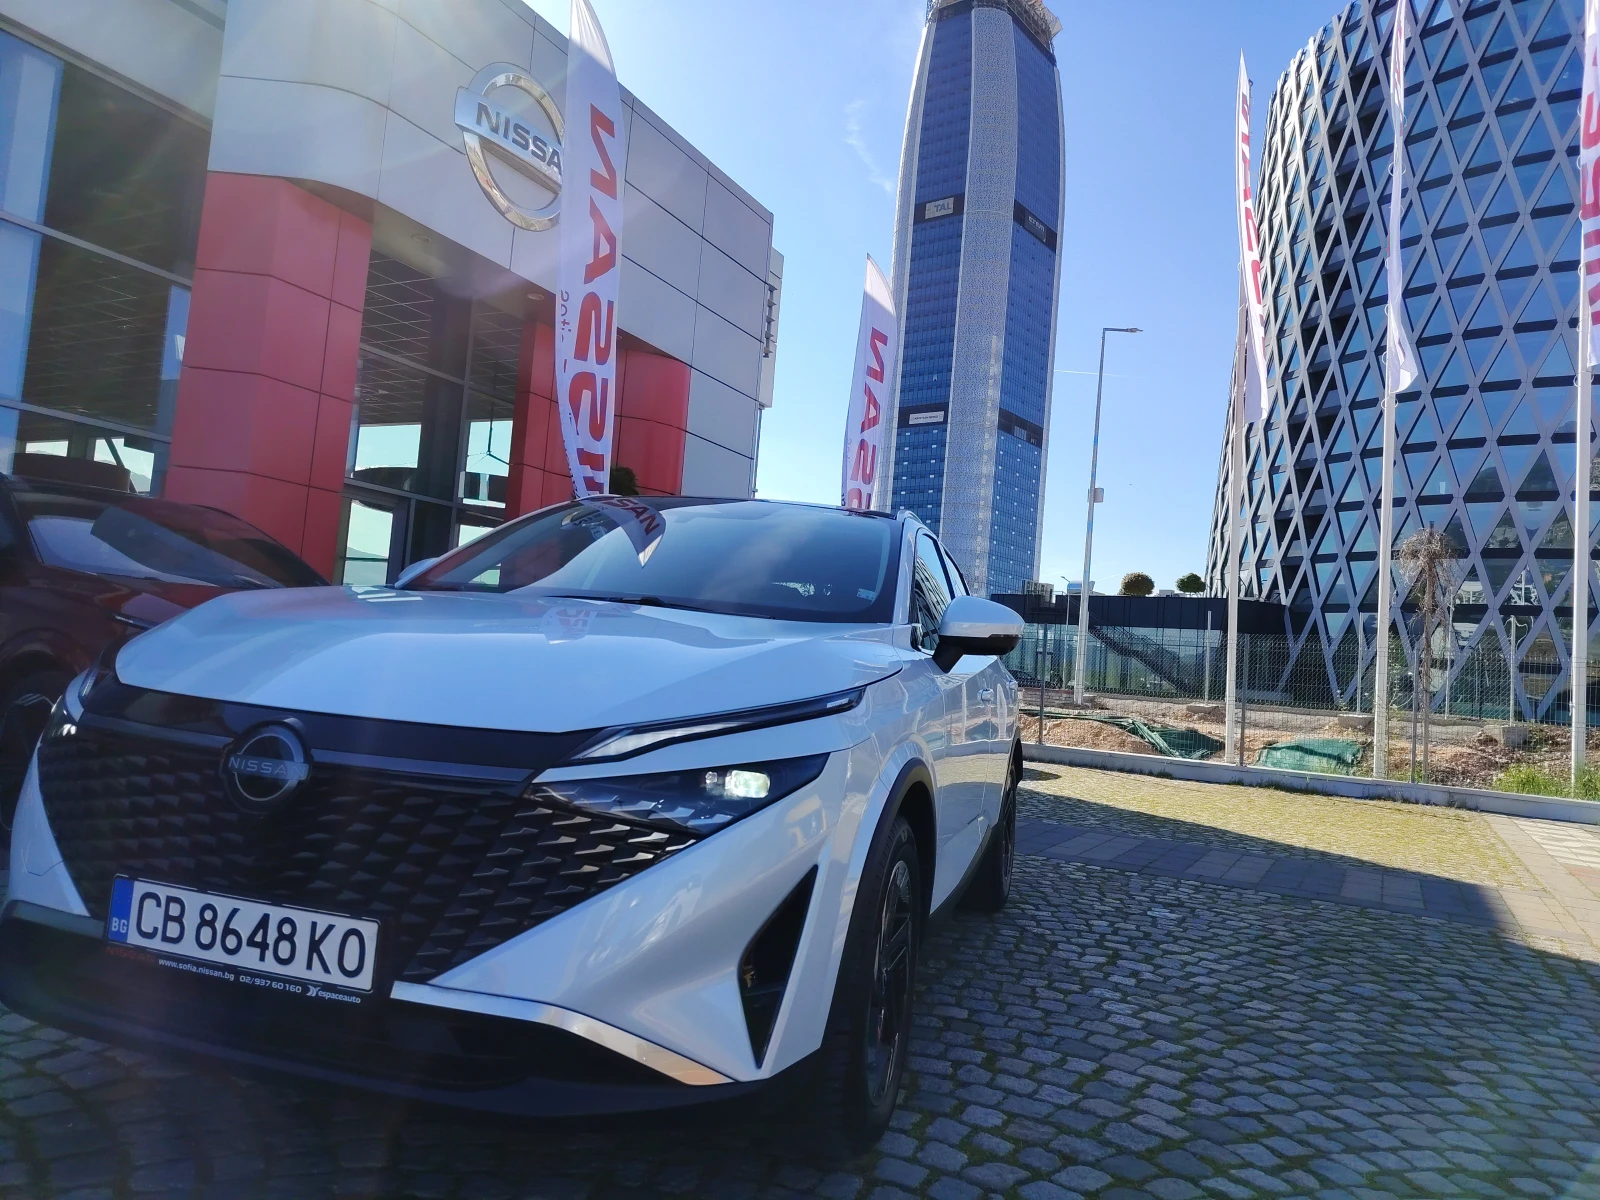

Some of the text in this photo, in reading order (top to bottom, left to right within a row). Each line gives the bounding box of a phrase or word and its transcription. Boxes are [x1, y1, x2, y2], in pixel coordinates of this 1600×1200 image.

[476, 101, 563, 175] NISSA
[228, 756, 308, 779] NISSAN
[111, 917, 128, 934] BG
[135, 891, 367, 979] CB 8648 KO
[158, 958, 235, 982] www.sofia.nissan.bg
[239, 974, 302, 993] 02/937 60 160
[318, 990, 361, 1004] espaceauto
